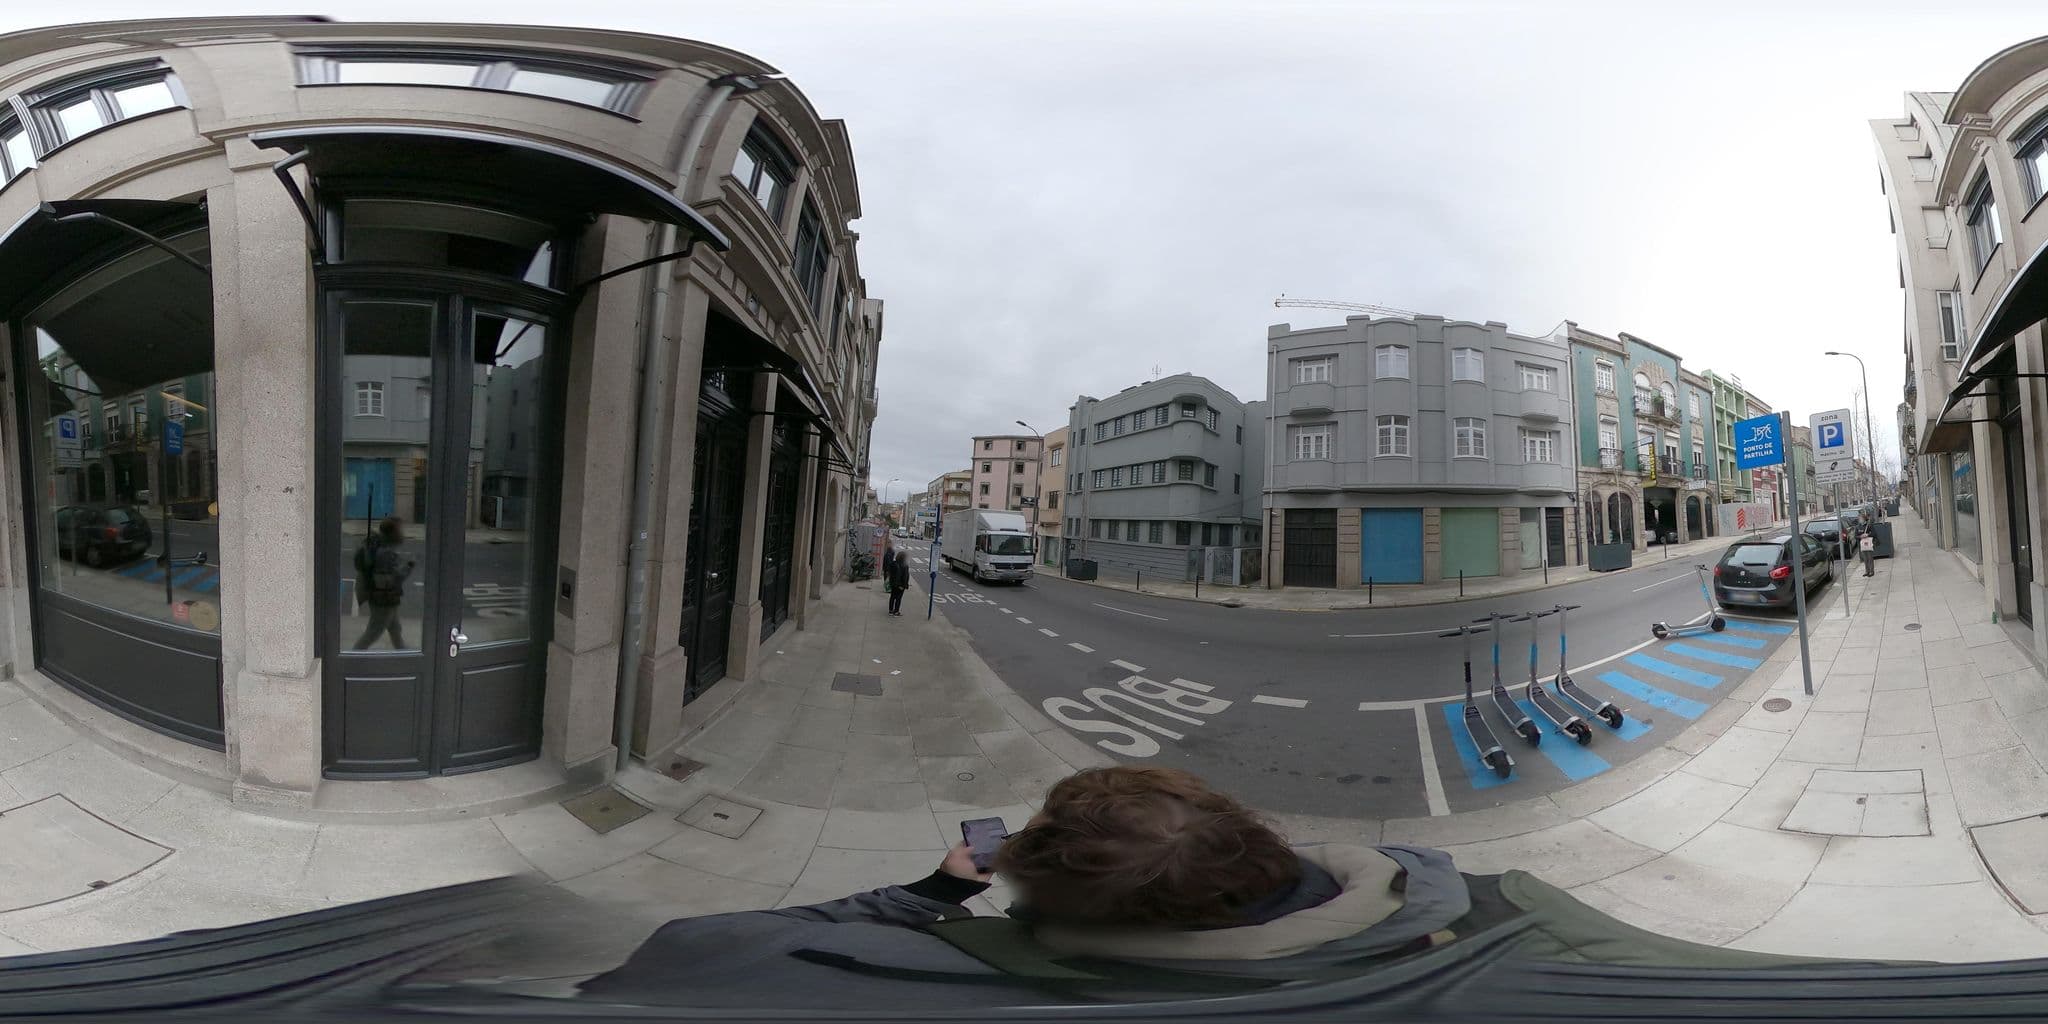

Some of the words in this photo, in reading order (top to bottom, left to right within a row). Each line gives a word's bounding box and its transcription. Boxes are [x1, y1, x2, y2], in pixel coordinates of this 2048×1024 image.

[1823, 425, 1838, 446] P
[1744, 444, 1764, 452] PONTO
[1744, 450, 1774, 460] PARTILHA
[930, 593, 984, 604] BUS
[1042, 676, 1234, 758] BUS
